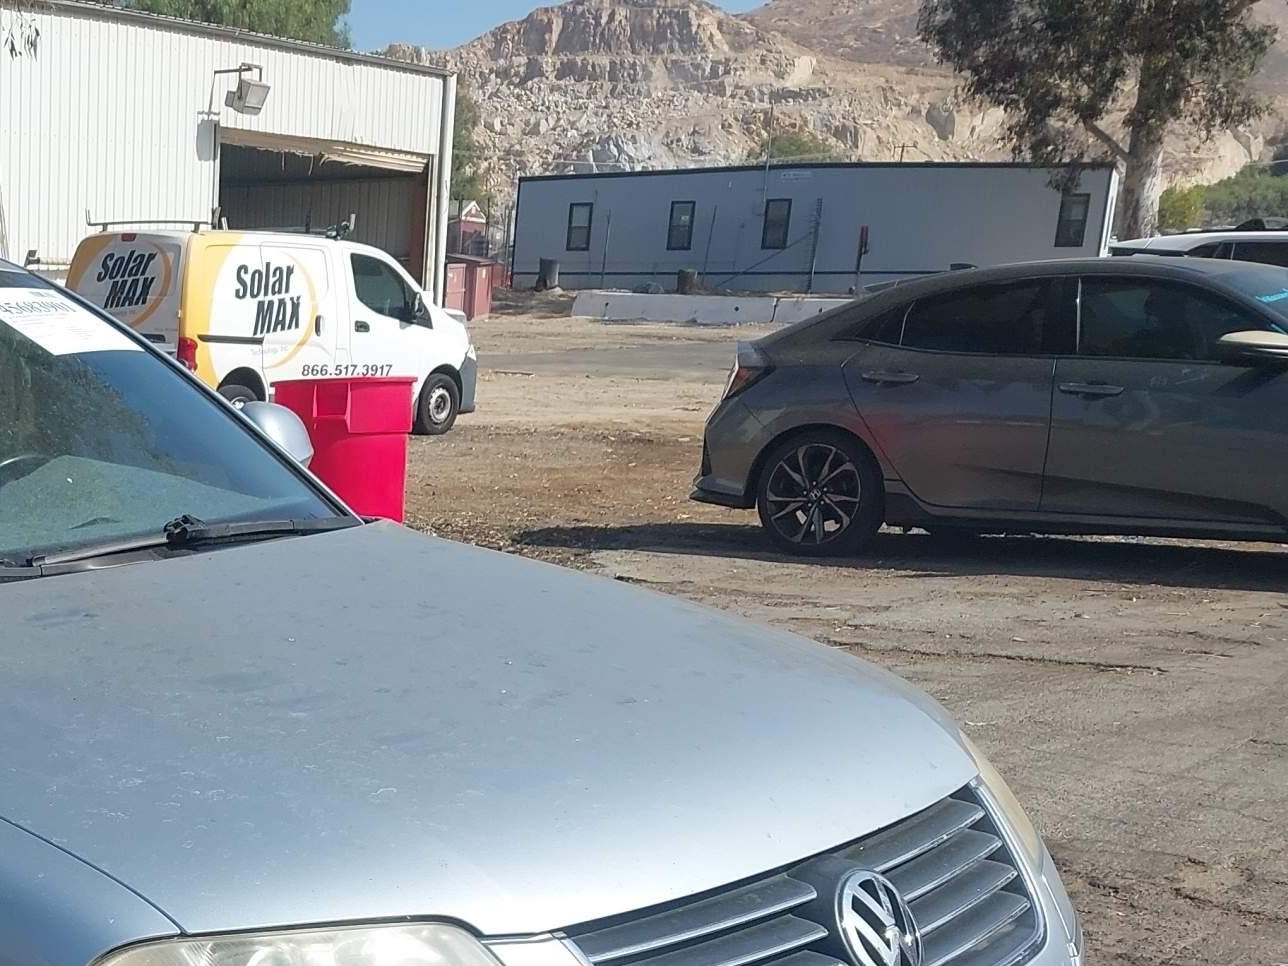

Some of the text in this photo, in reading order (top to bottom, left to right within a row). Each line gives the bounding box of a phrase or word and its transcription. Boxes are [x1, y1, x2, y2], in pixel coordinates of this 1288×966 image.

[96, 250, 158, 283] Solar
[234, 261, 295, 300] Solar
[103, 276, 156, 309] MAX
[252, 294, 302, 336] MAX
[301, 363, 393, 377] 866.517.3917
